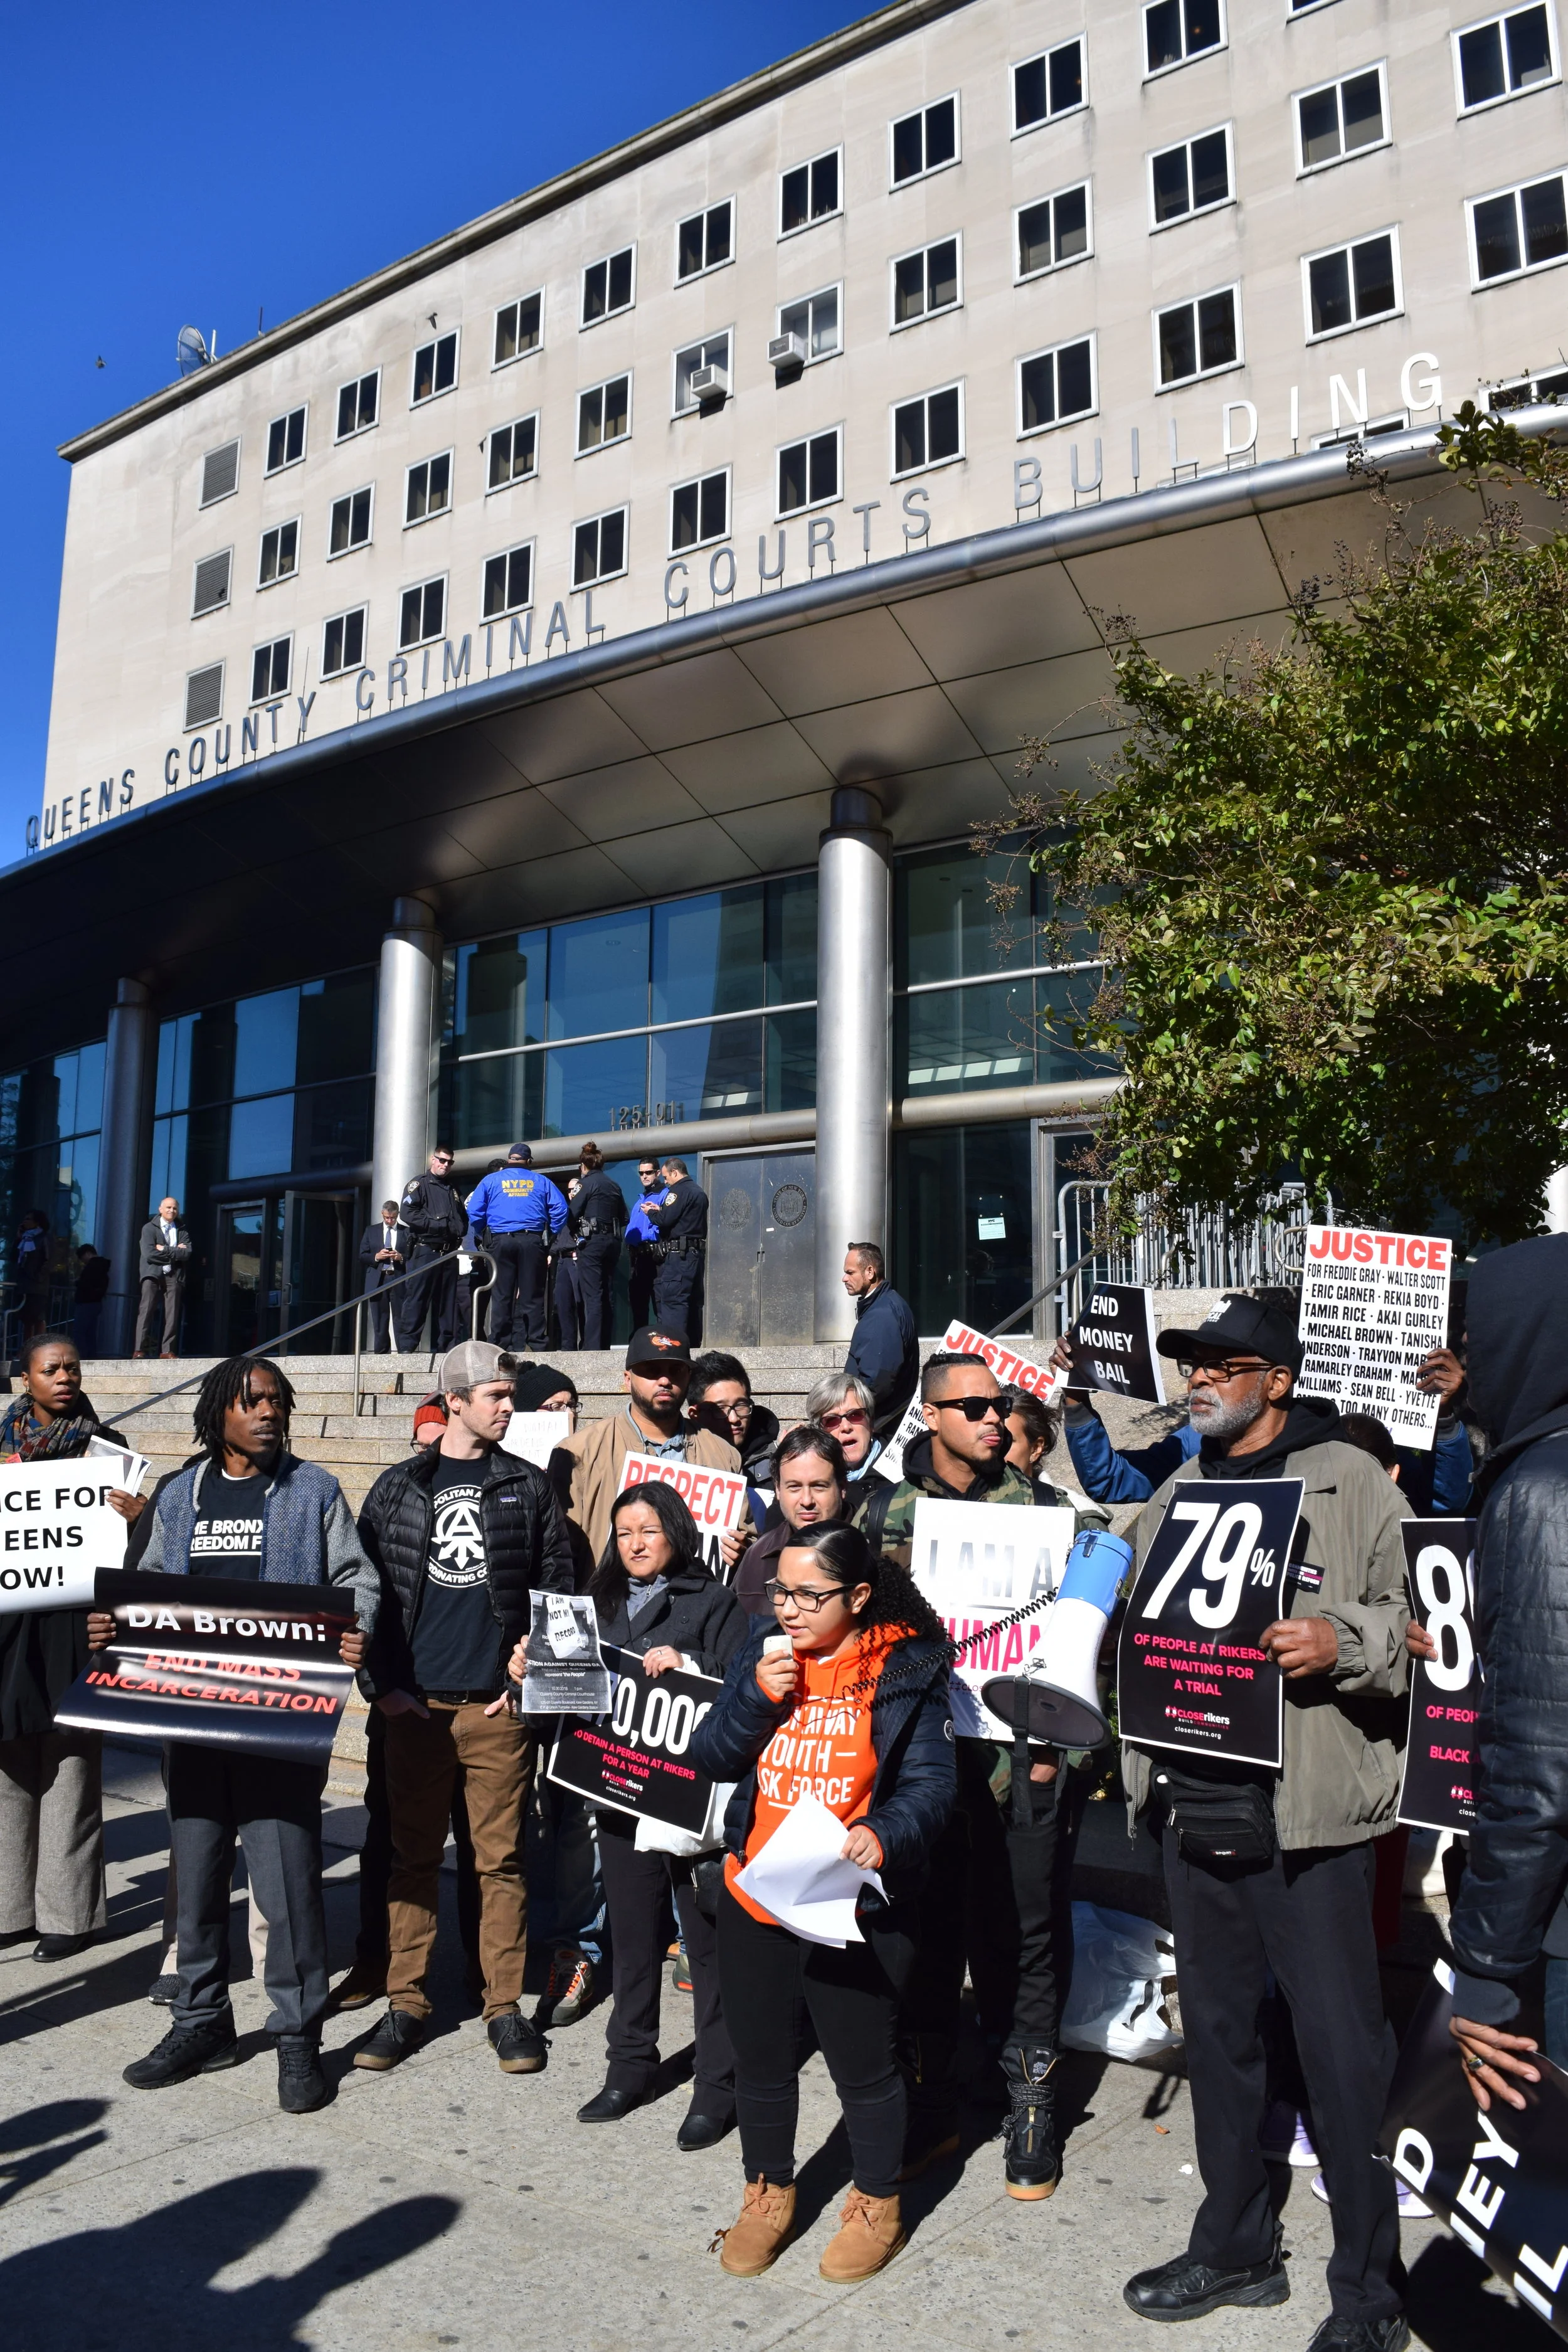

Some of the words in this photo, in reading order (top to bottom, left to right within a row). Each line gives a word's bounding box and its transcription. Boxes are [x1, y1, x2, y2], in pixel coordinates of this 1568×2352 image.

[26, 768, 134, 848] QUEENS
[165, 691, 316, 785] COUNTY
[356, 590, 606, 711] CRIMINAL
[664, 487, 931, 608] COURTS
[1014, 352, 1442, 509] BUILDING
[502, 1180, 534, 1188] NYPD
[797, 1189, 807, 1200] YORK
[1310, 1230, 1447, 1271] JUSTICE
[1307, 1263, 1322, 1278] FOR
[1323, 1264, 1357, 1281] FREDDIE
[1359, 1268, 1381, 1283] GRAY
[1387, 1270, 1418, 1288] WALTER
[1421, 1274, 1446, 1291] SCOTT
[1090, 1295, 1118, 1316] END
[1311, 1283, 1334, 1300] ERIC
[1337, 1285, 1375, 1303] GARNER
[1384, 1290, 1411, 1307] REKIA
[1414, 1293, 1439, 1310] BOYD
[1305, 1302, 1339, 1320] TAMIR
[1342, 1306, 1367, 1322] RICE
[1377, 1309, 1401, 1325] AKAI
[1405, 1312, 1444, 1330] GURLEY
[1079, 1326, 1133, 1353] MONEY
[1307, 1322, 1352, 1340] MICHAEL
[1355, 1327, 1393, 1345] BROWN
[1401, 1332, 1443, 1349] TANISHA
[946, 1328, 1055, 1400] JUSTICE
[1359, 1347, 1402, 1365] TRAYVON
[1094, 1360, 1130, 1384] BAIL
[1305, 1359, 1352, 1377] RAMARLEY
[1354, 1365, 1392, 1382] GRAHAM
[1298, 1376, 1342, 1394] WILLIAMS
[1350, 1382, 1374, 1399] SEAN
[1375, 1385, 1396, 1402] BELL
[1406, 1390, 1437, 1409] YVETTE
[1362, 1402, 1389, 1421] MANY
[1391, 1408, 1433, 1429] OTHERS...
[0, 1490, 41, 1513] CE
[5, 1526, 83, 1551] EENS
[211, 1519, 263, 1534] BRONX
[0, 1566, 64, 1590] OW!
[957, 1541, 1015, 1598] AM
[1029, 1547, 1056, 1600] A
[1142, 1502, 1275, 1629] 79%
[126, 1606, 181, 1631] DA
[193, 1610, 326, 1641] Brown:
[549, 1610, 562, 1621] NOT
[1416, 1545, 1485, 1692] 8
[938, 1616, 1041, 1672] UMA
[1134, 1633, 1150, 1646] OF
[1152, 1636, 1197, 1653] PEOPLE
[1199, 1643, 1216, 1655] AT
[1219, 1645, 1266, 1661] RIKERS
[143, 1653, 207, 1674] END
[211, 1659, 301, 1682] MASS
[1144, 1655, 1167, 1668] ARE
[1169, 1658, 1223, 1677] WAITING
[1227, 1665, 1254, 1680] FOR
[85, 1670, 337, 1714] INCARCERATION
[1173, 1678, 1183, 1690] A
[1185, 1680, 1222, 1696] TRIAL
[1426, 1705, 1444, 1719] OF
[1174, 1726, 1221, 1740] closerikers.org
[583, 1732, 608, 1749] DETAIN
[608, 1743, 615, 1752] A
[616, 1745, 649, 1765] PERSON
[650, 1758, 663, 1769] AT
[663, 1762, 696, 1781] RIKERS
[602, 1753, 618, 1767] FOR
[619, 1761, 626, 1770] A
[627, 1764, 650, 1779] YEAR
[761, 1733, 832, 1773] YOUTH
[1429, 1745, 1470, 1763] BLACK
[606, 1786, 636, 1801] closerikers.org
[757, 1767, 783, 1799] SK
[787, 1776, 854, 1806] FORCE
[1392, 2127, 1434, 2194] D
